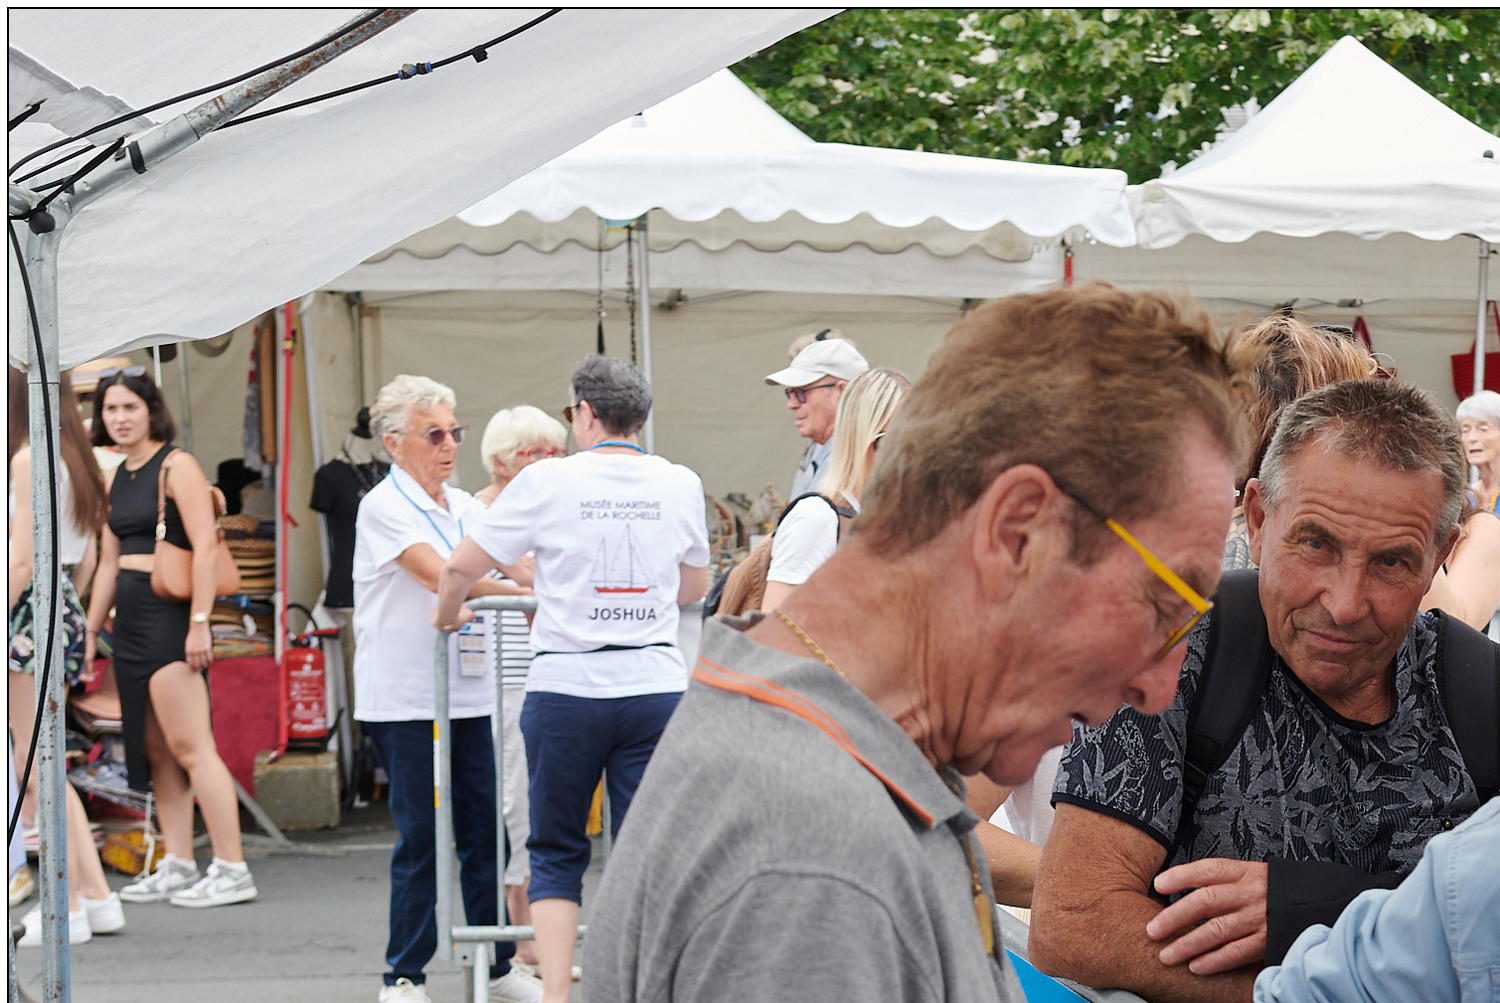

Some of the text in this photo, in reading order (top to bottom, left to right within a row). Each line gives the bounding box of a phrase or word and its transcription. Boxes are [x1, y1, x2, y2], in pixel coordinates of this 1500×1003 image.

[580, 499, 661, 510] MUSÉE MARITIME
[581, 510, 662, 520] DE LA ROCHELLE
[588, 607, 657, 621] JOSHUA
